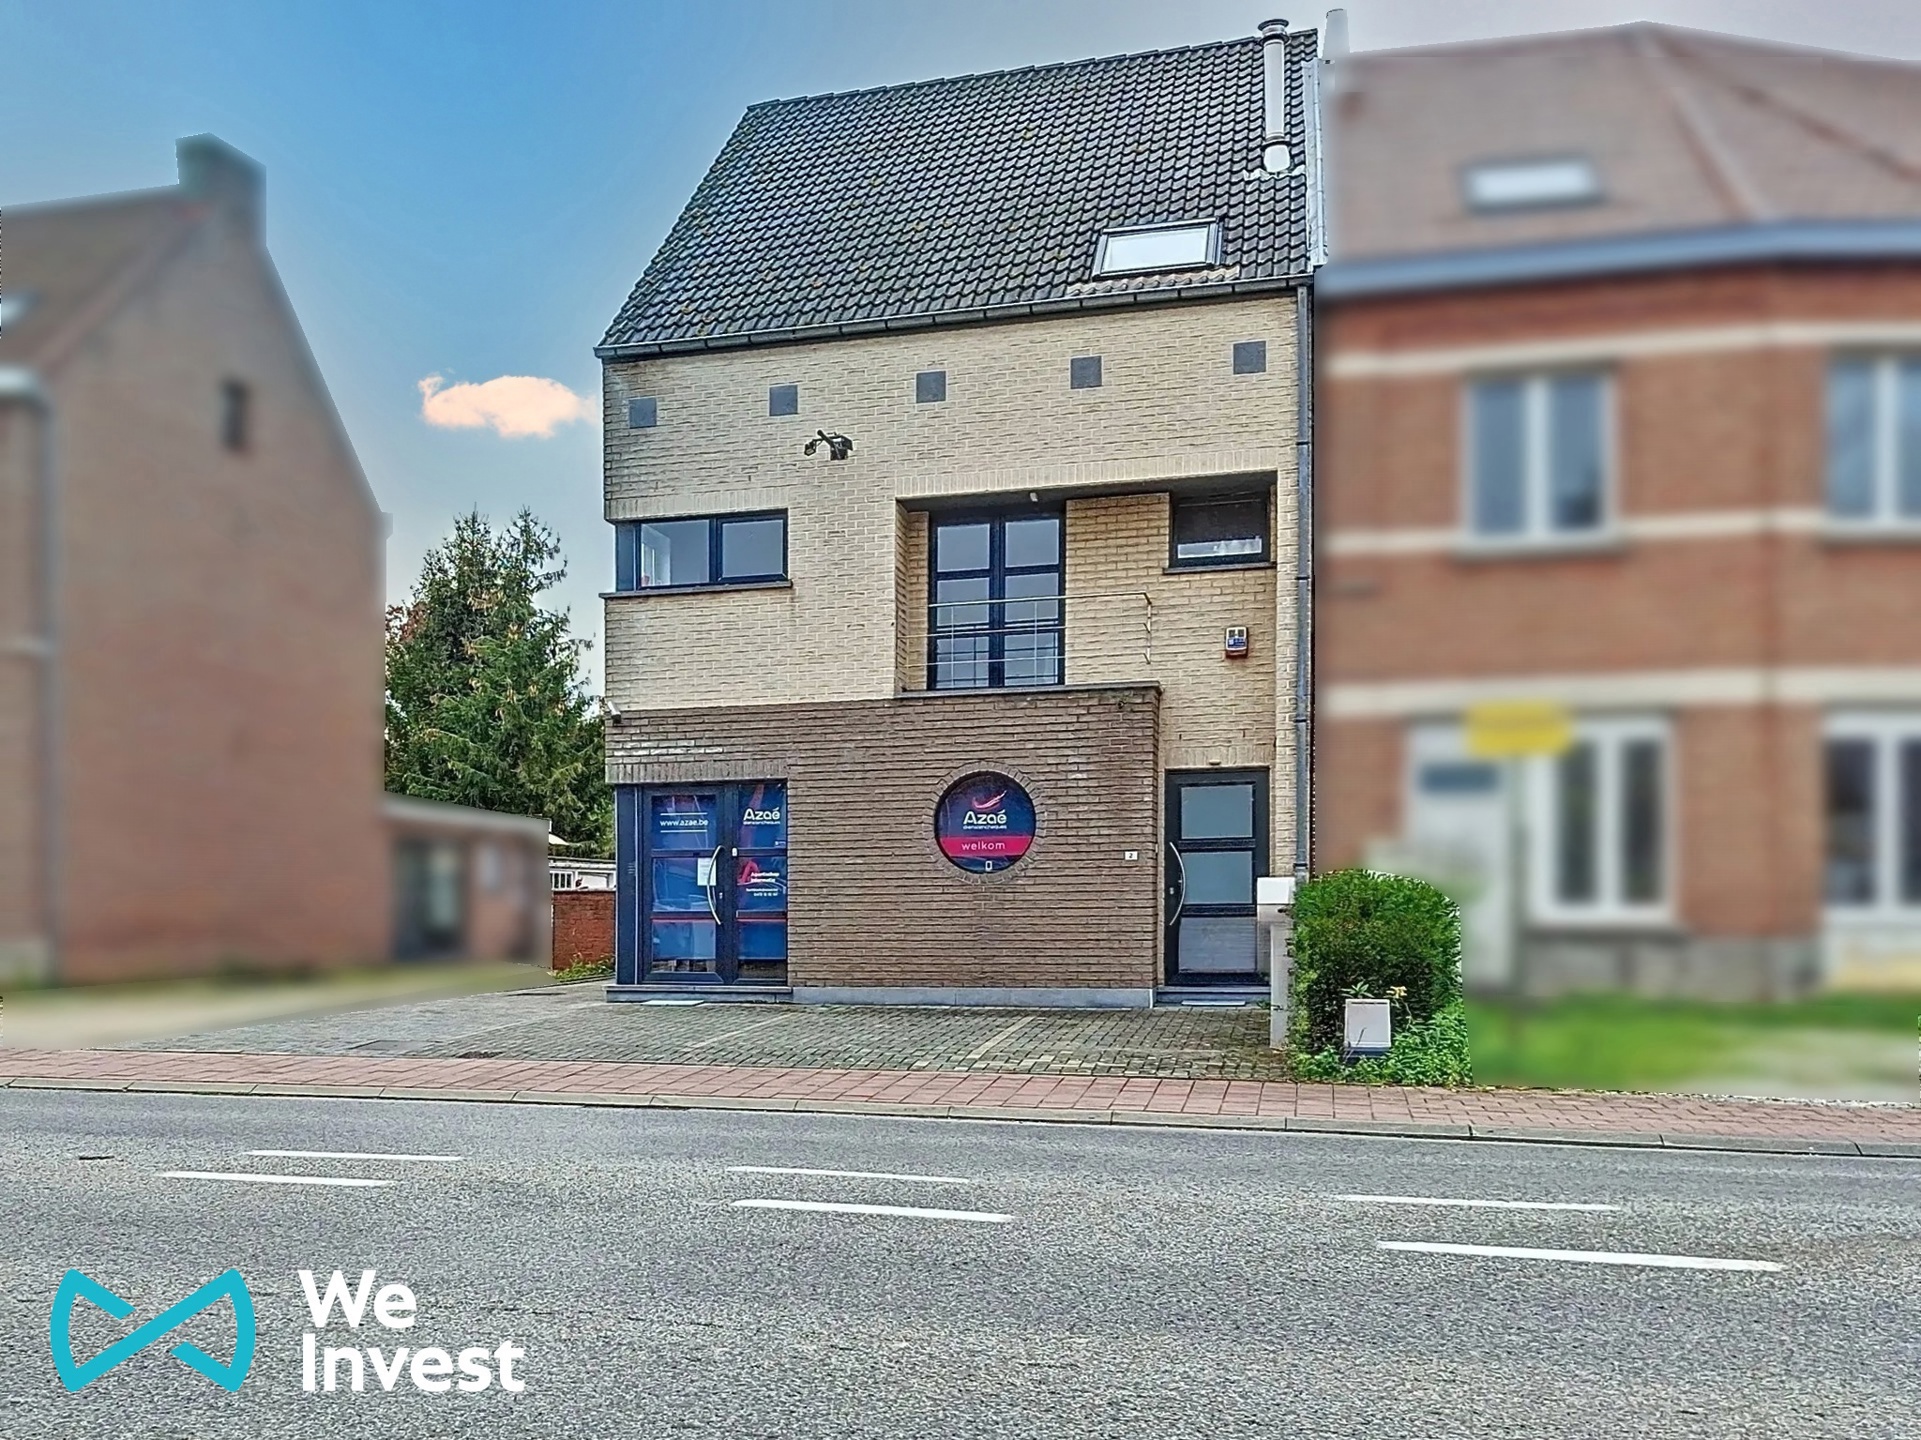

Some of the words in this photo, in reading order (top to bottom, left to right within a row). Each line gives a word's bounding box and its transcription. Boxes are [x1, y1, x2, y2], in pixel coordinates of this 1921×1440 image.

[743, 807, 781, 821] Azaé
[963, 809, 1008, 825] Azaé
[660, 819, 709, 827] www.azae.be
[961, 841, 1006, 851] welkom
